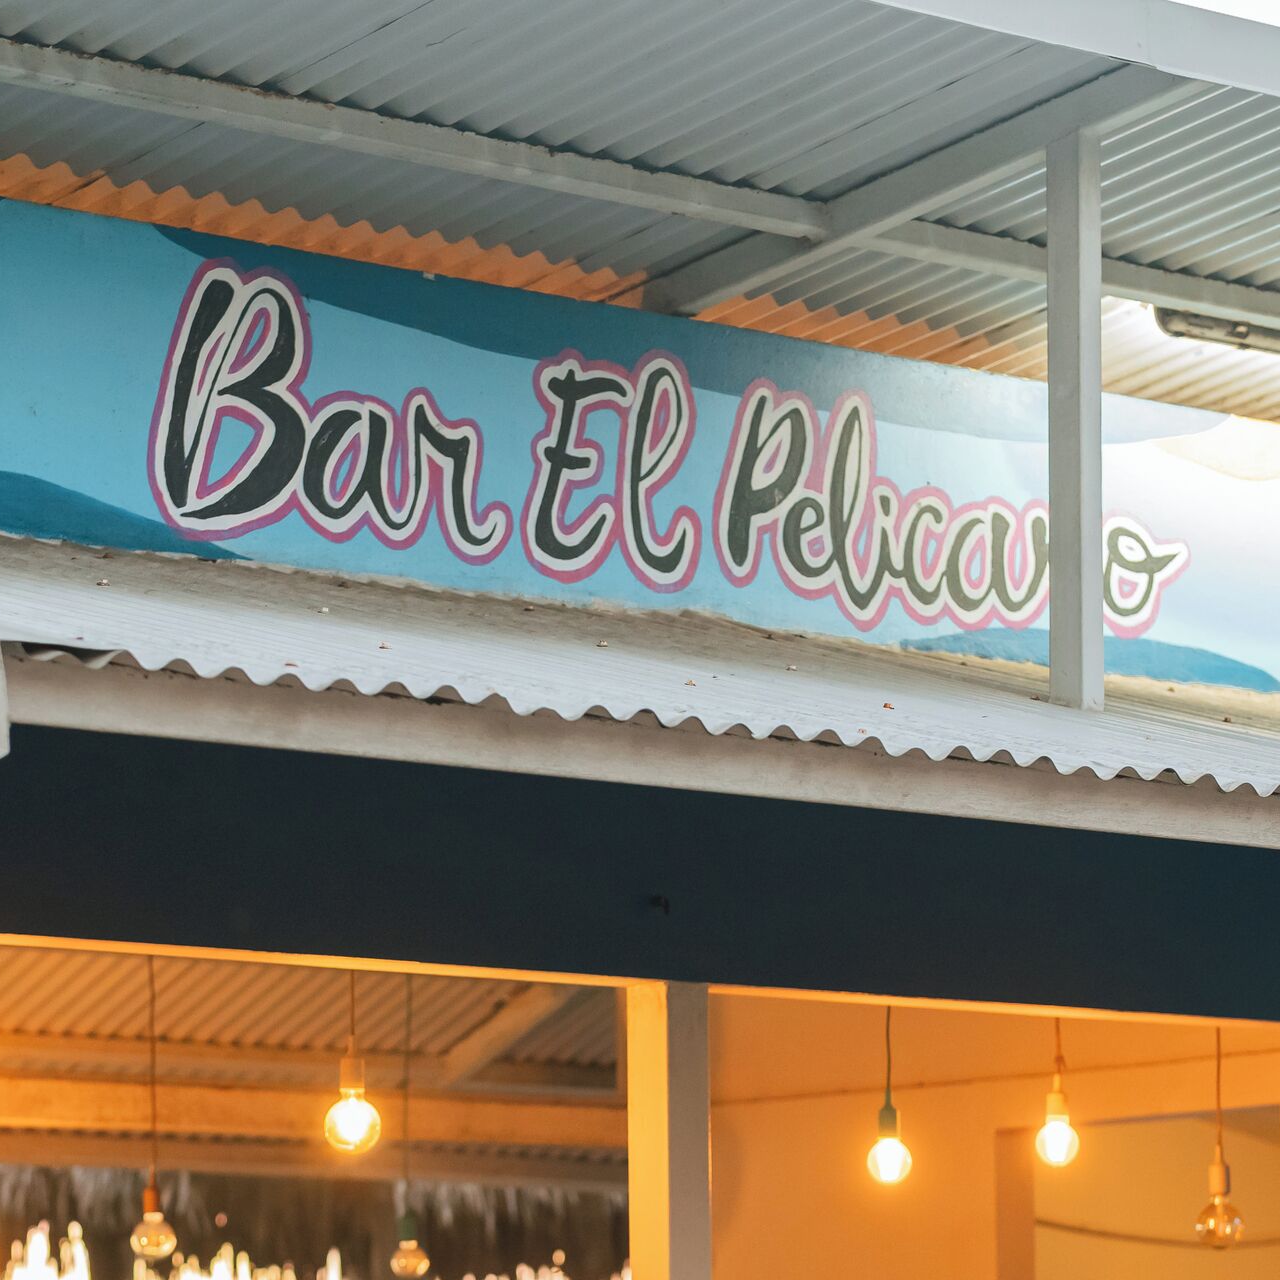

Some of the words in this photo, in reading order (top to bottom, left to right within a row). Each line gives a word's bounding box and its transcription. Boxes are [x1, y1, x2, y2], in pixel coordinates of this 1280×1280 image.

[154, 263, 505, 559] Bar
[526, 357, 697, 584] El
[716, 384, 1190, 628] Pelicao
